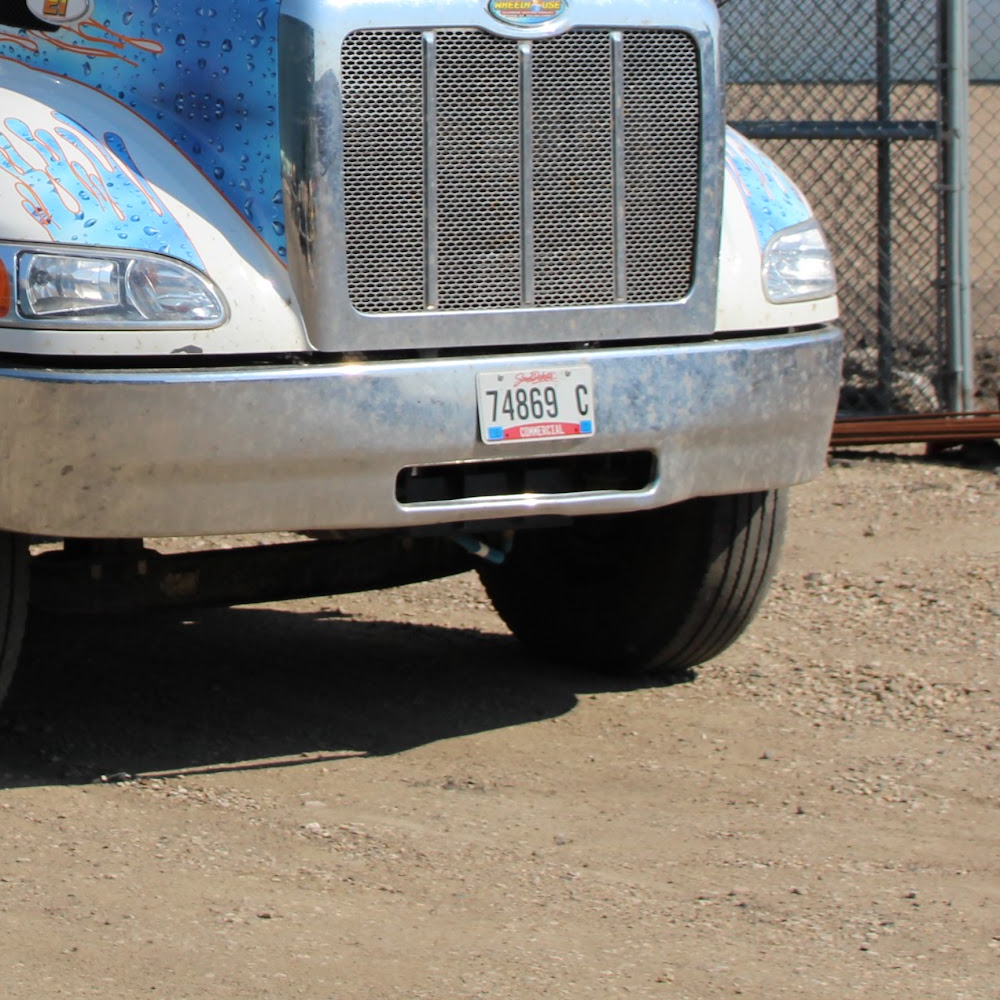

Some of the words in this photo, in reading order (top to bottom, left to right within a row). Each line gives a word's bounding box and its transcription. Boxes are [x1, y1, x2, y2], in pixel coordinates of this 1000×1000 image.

[485, 386, 558, 422] 74869
[575, 384, 589, 416] C
[519, 424, 565, 438] COMMERCIAL
